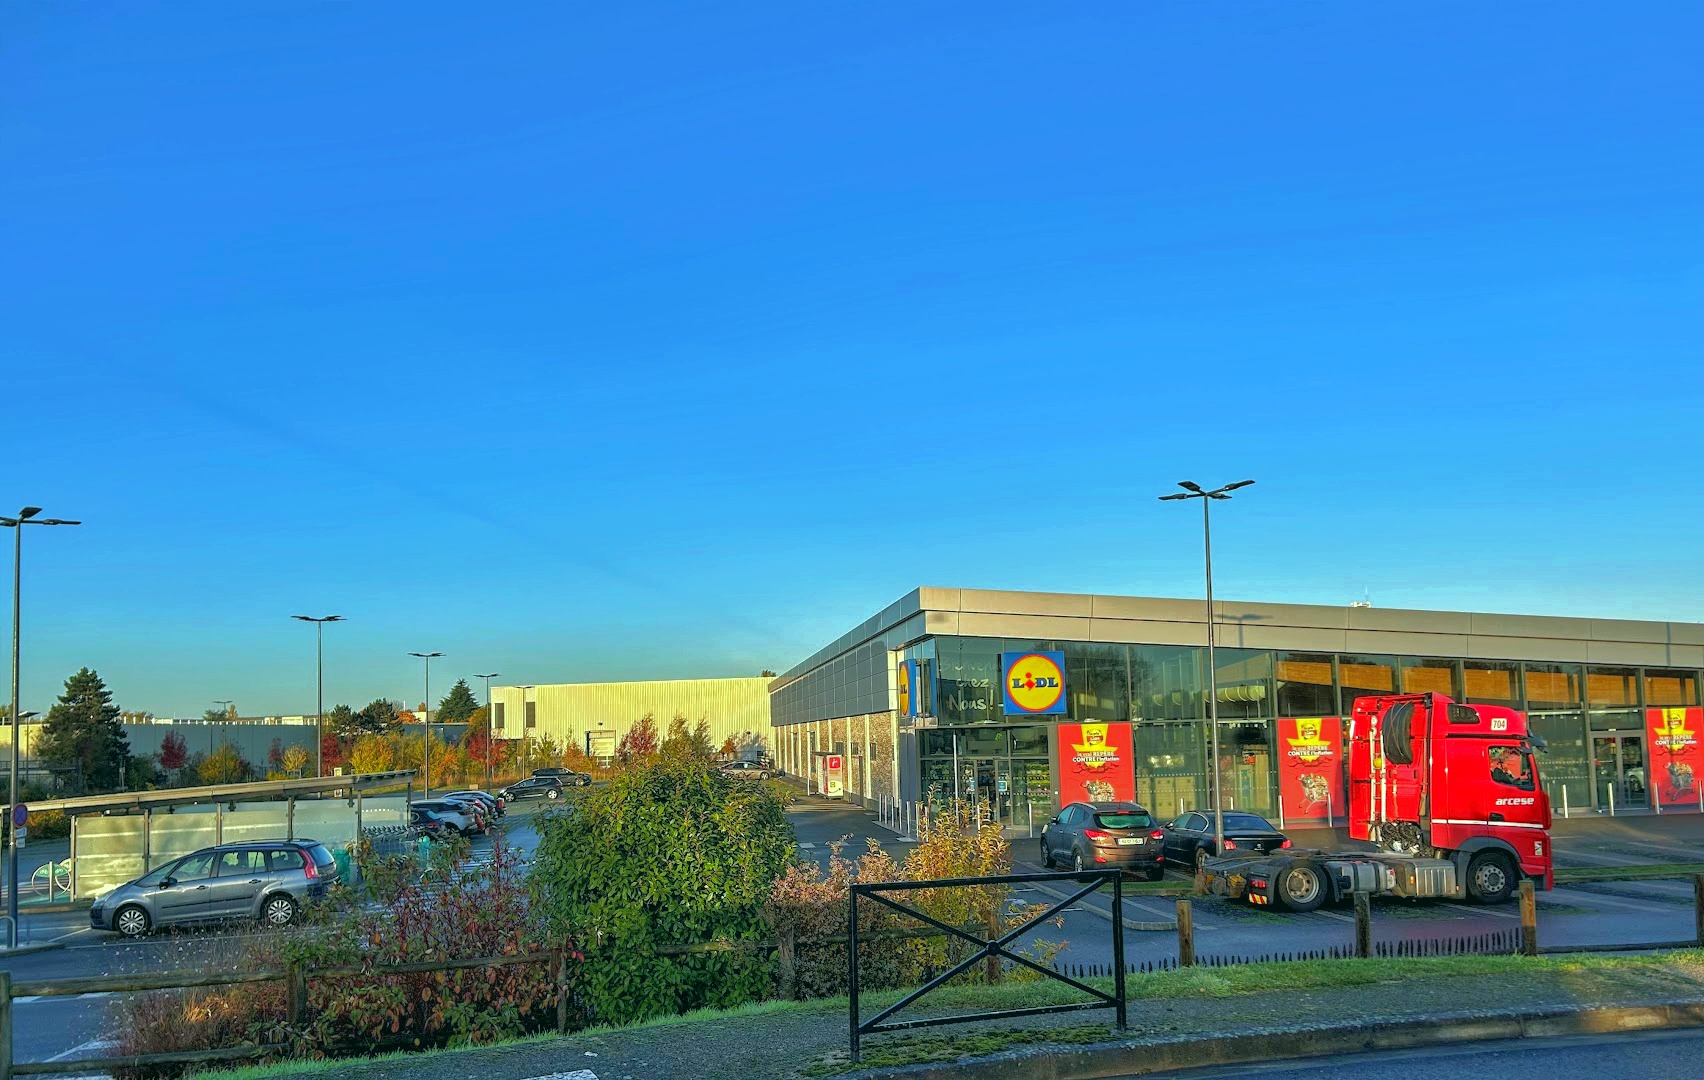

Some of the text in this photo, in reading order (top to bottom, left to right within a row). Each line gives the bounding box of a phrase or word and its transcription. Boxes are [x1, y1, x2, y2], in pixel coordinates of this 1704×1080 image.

[956, 674, 990, 688] chez
[1493, 719, 1506, 729] 704
[1495, 797, 1534, 806] arcese
